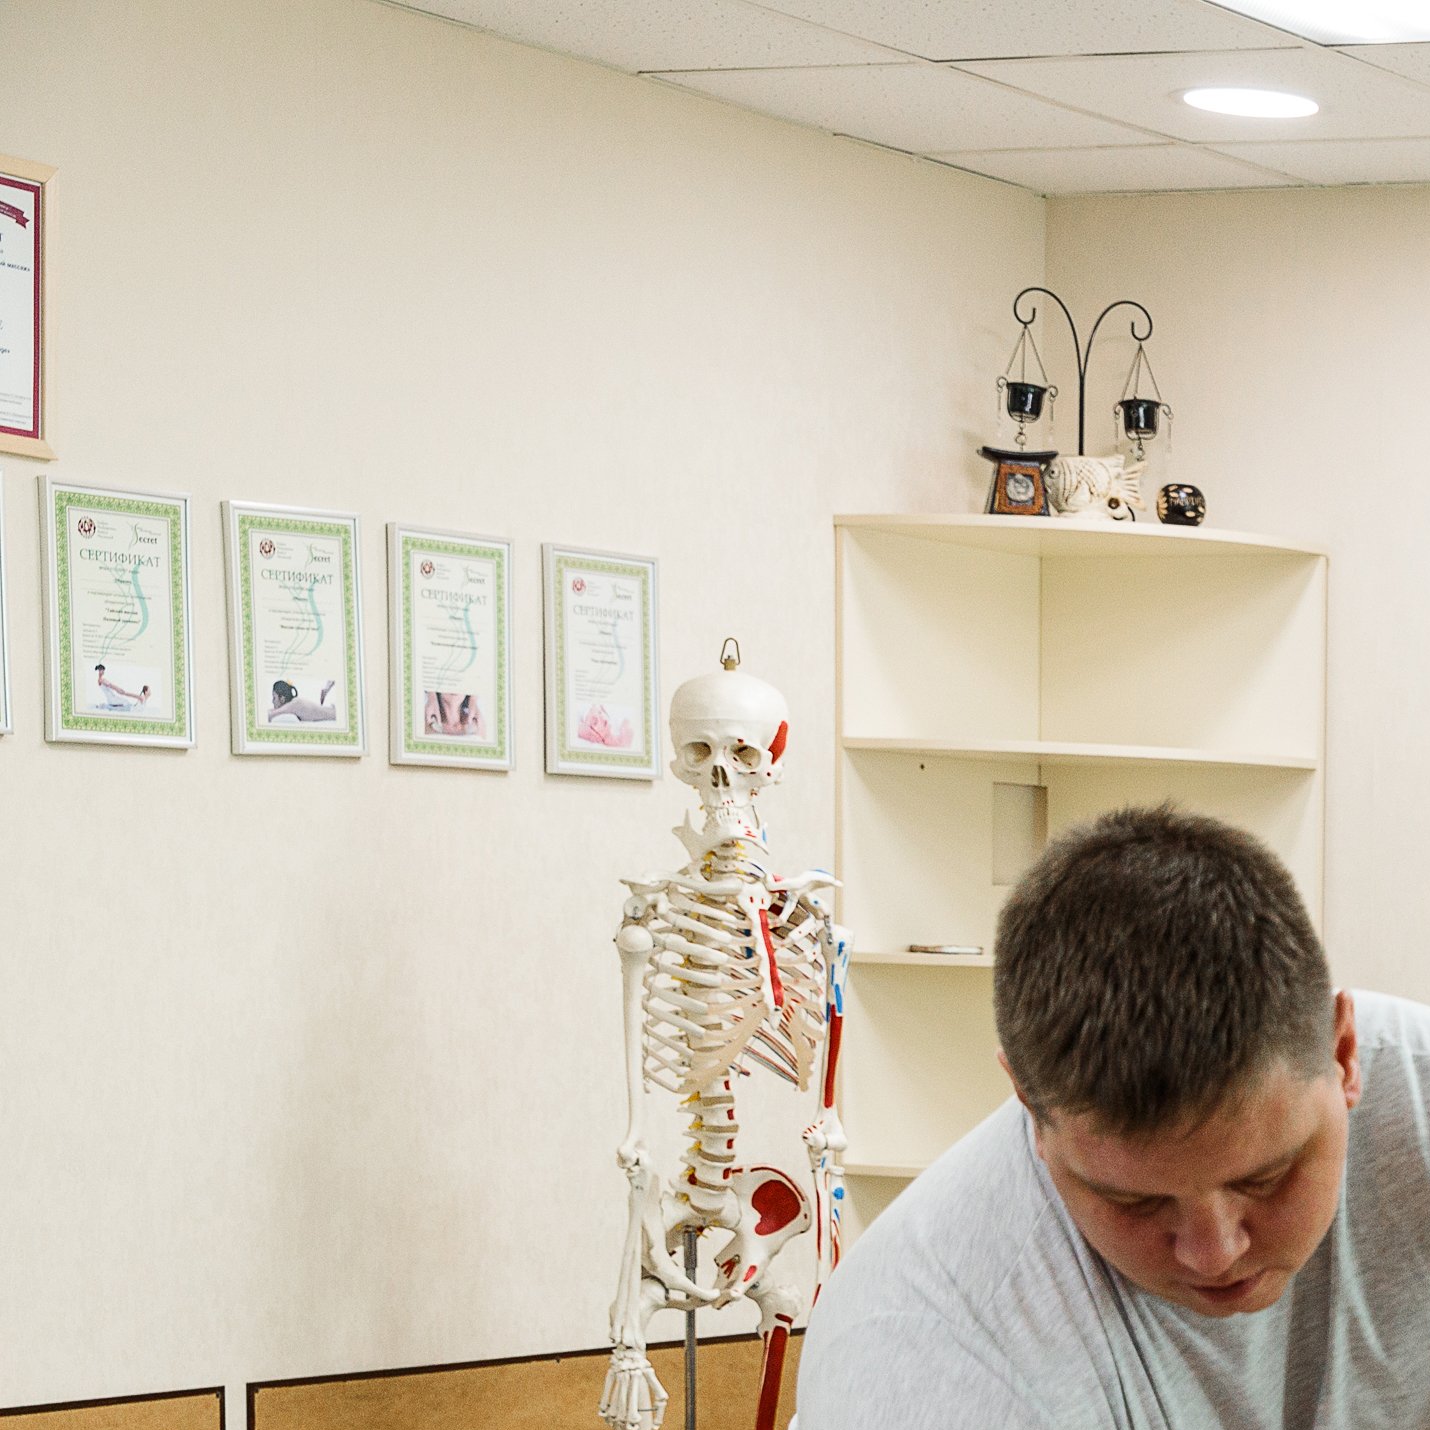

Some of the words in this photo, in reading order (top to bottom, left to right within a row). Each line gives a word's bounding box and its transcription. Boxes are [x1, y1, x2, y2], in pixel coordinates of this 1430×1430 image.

[79, 547, 160, 568] СЕРТИФИКАТ
[260, 568, 334, 585] СЕРТИФИКАТ
[420, 588, 487, 606] СЕРТИФИКАТ
